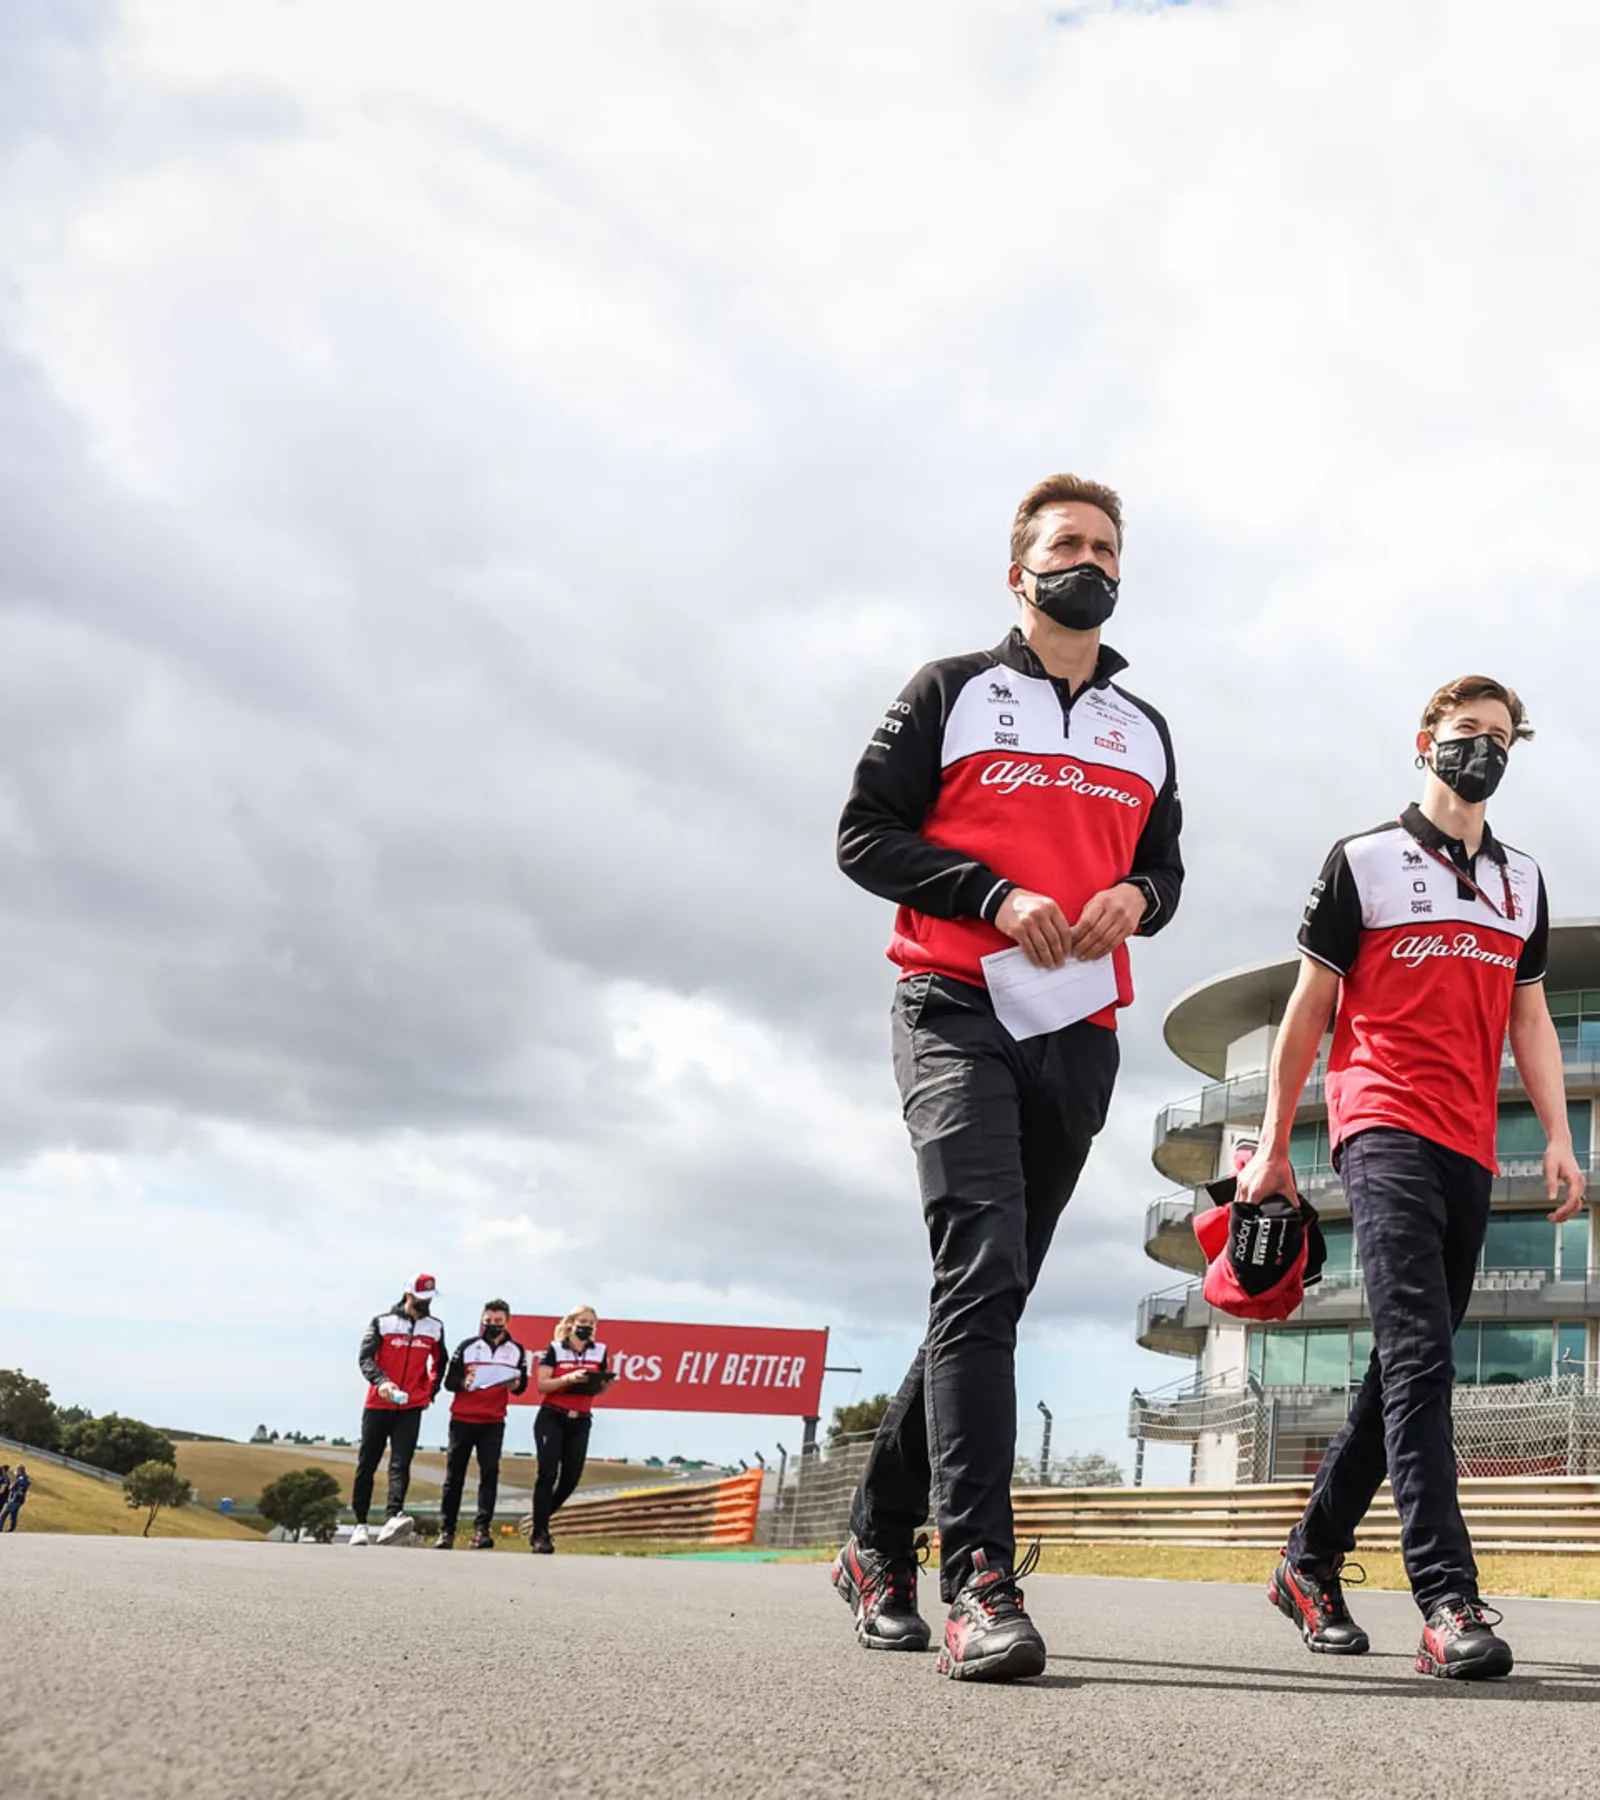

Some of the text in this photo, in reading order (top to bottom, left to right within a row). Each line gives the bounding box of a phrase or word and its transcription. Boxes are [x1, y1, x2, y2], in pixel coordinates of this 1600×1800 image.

[994, 736, 1019, 747] ONE
[980, 761, 1142, 808] Alfa Romeo
[1411, 905, 1433, 914] ONE
[1391, 935, 1453, 968] Alfa
[675, 1351, 719, 1384] FLY
[720, 1353, 806, 1388] BETTER
